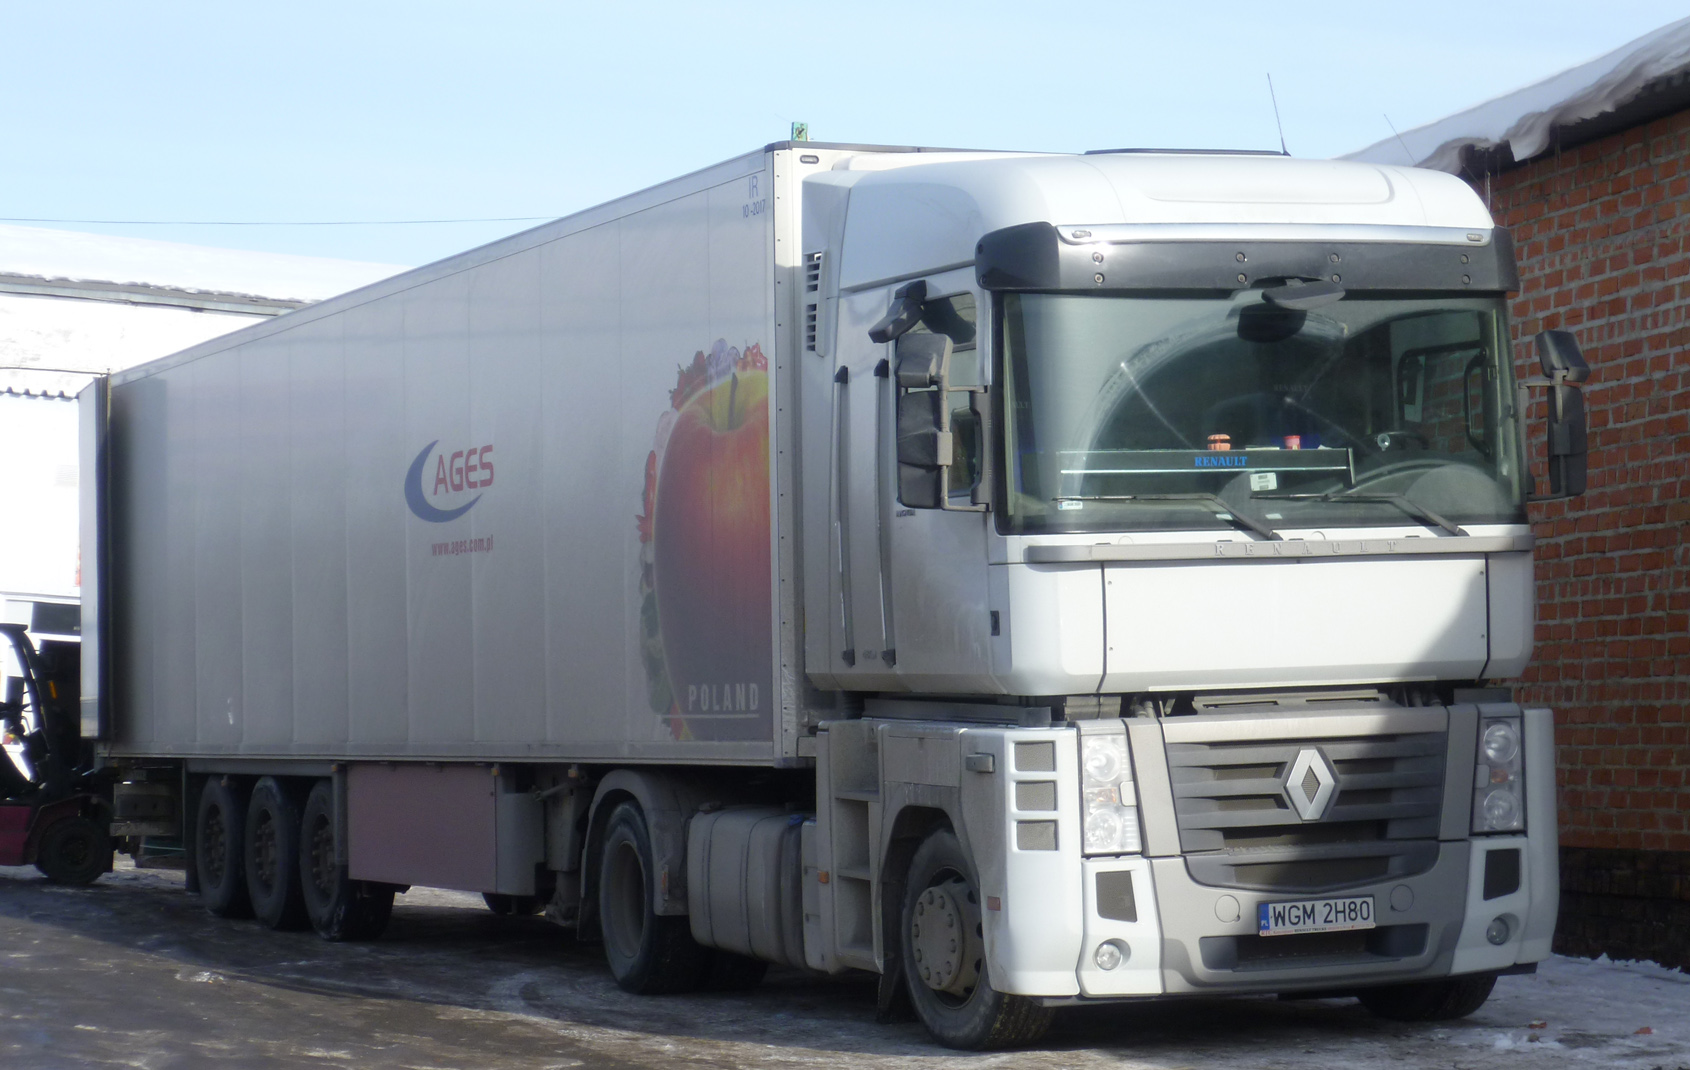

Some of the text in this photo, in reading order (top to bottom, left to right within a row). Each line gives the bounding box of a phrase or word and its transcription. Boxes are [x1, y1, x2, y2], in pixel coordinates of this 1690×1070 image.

[433, 444, 494, 496] AGES
[1194, 456, 1248, 468] RENAULT
[431, 534, 494, 556] www.ages.com.pl
[1214, 540, 1397, 557] RENAULT
[688, 682, 759, 711] POLAND
[1273, 900, 1370, 927] WGM 2H80
